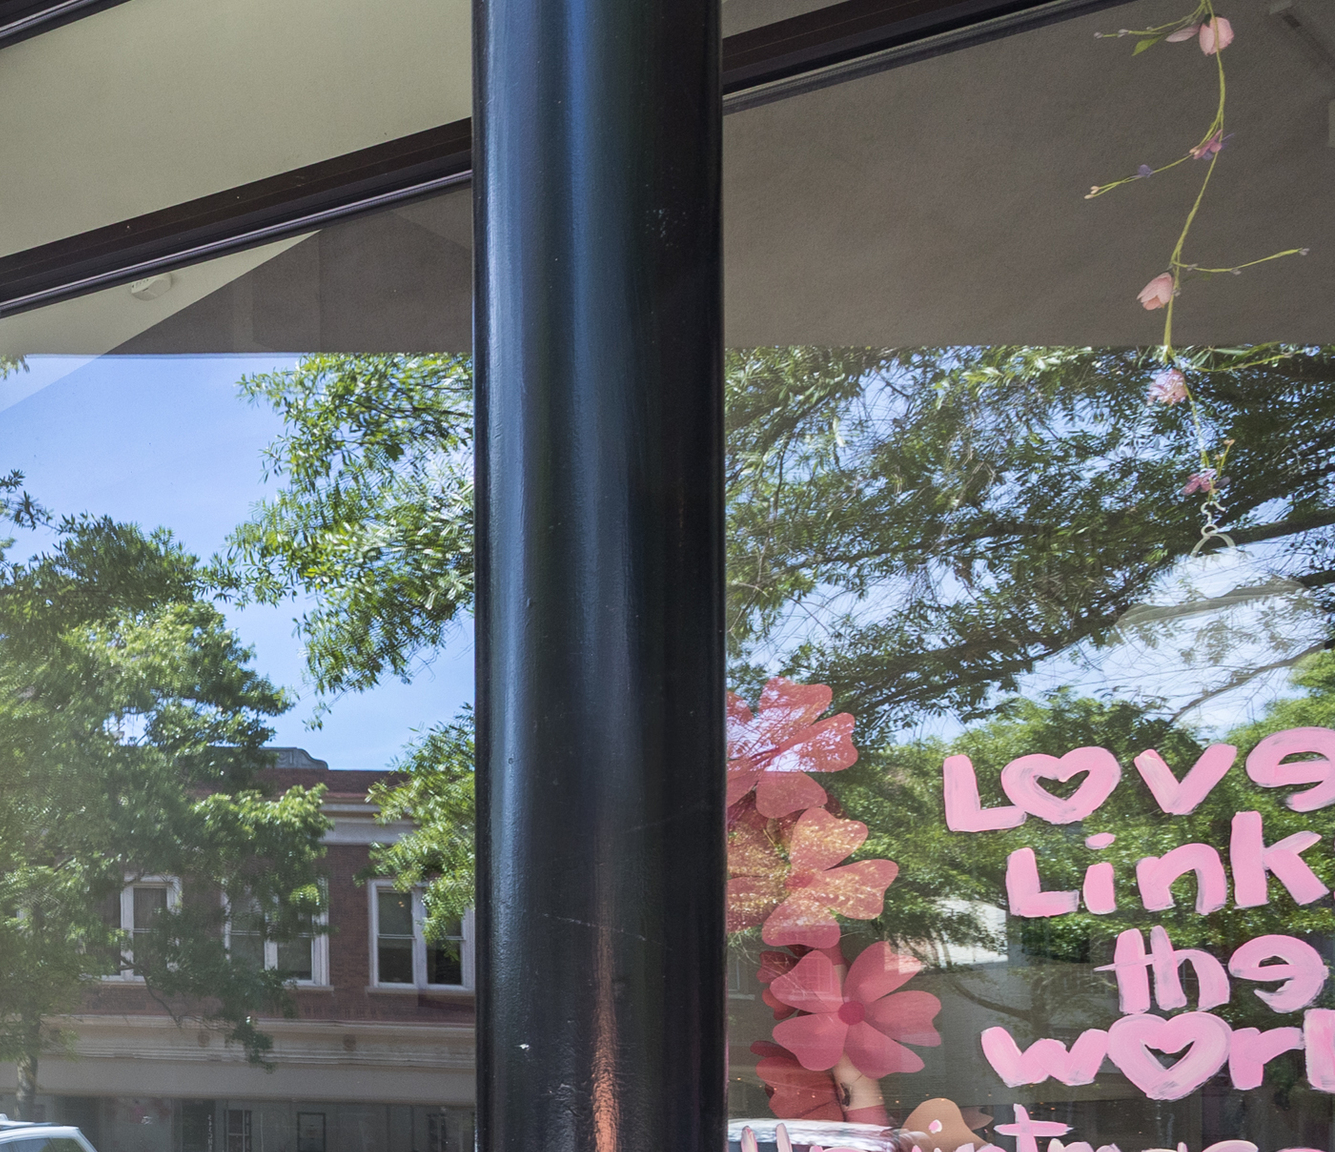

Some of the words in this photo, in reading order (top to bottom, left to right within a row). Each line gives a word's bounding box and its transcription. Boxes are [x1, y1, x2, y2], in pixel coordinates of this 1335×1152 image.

[943, 727, 1335, 832] Love
[1006, 811, 1329, 917] Link
[1094, 926, 1329, 1013] the
